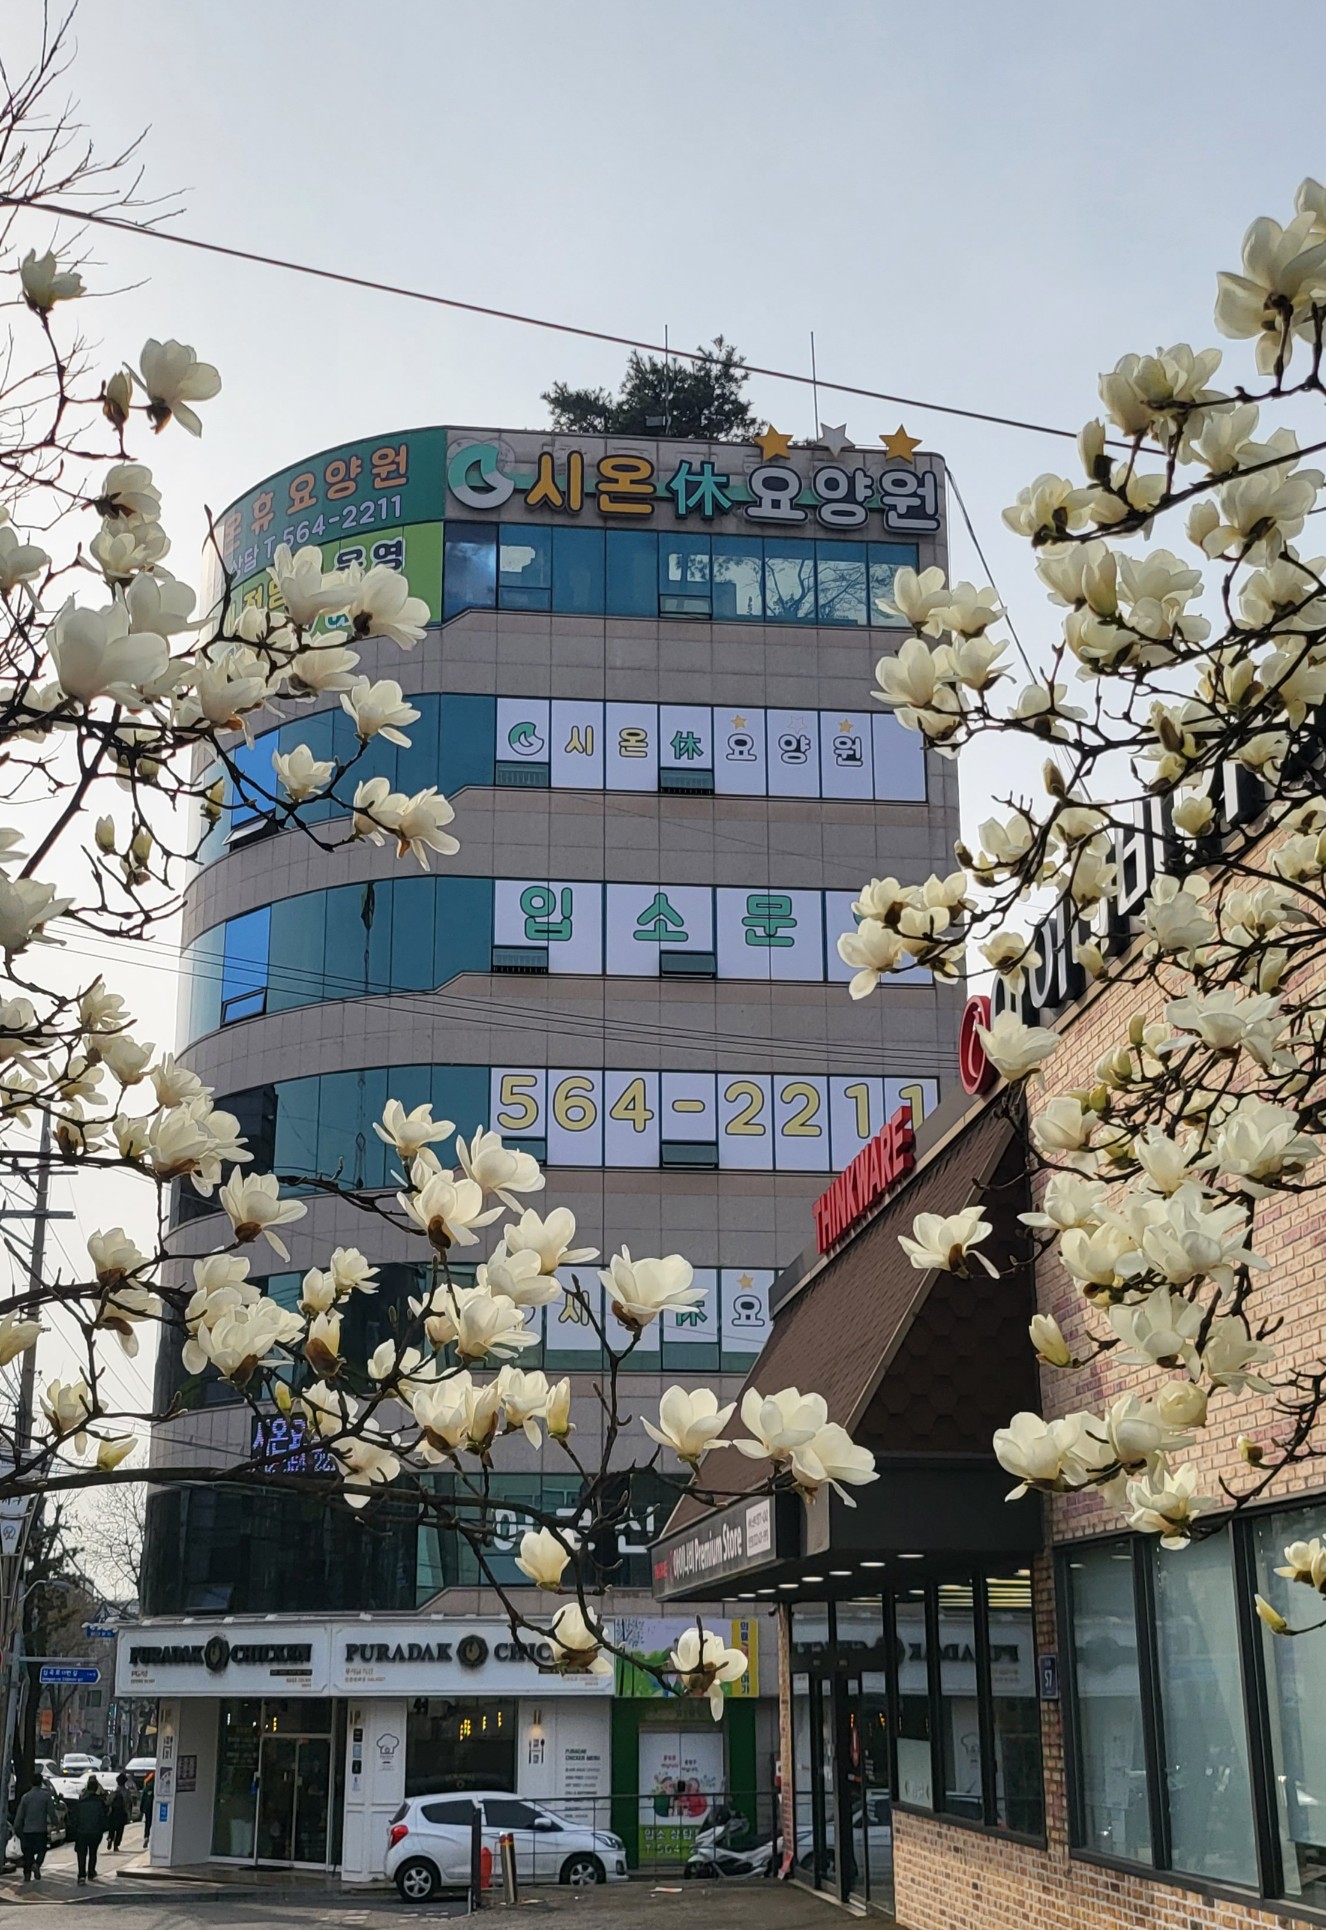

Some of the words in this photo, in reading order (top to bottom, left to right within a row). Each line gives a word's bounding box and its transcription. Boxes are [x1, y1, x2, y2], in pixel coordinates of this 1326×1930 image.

[286, 444, 408, 516] 요양원
[744, 463, 942, 534] 요양원
[282, 494, 402, 549] 564-2211
[725, 732, 864, 768] 요양원
[497, 1073, 925, 1139] 564-2211
[812, 1106, 917, 1255] THINKWARE
[695, 1530, 722, 1573] Premium
[722, 1523, 742, 1561] Store
[129, 1645, 205, 1664] PURADAK
[231, 1643, 312, 1663] CHICKEN
[345, 1643, 453, 1663] PURADAK
